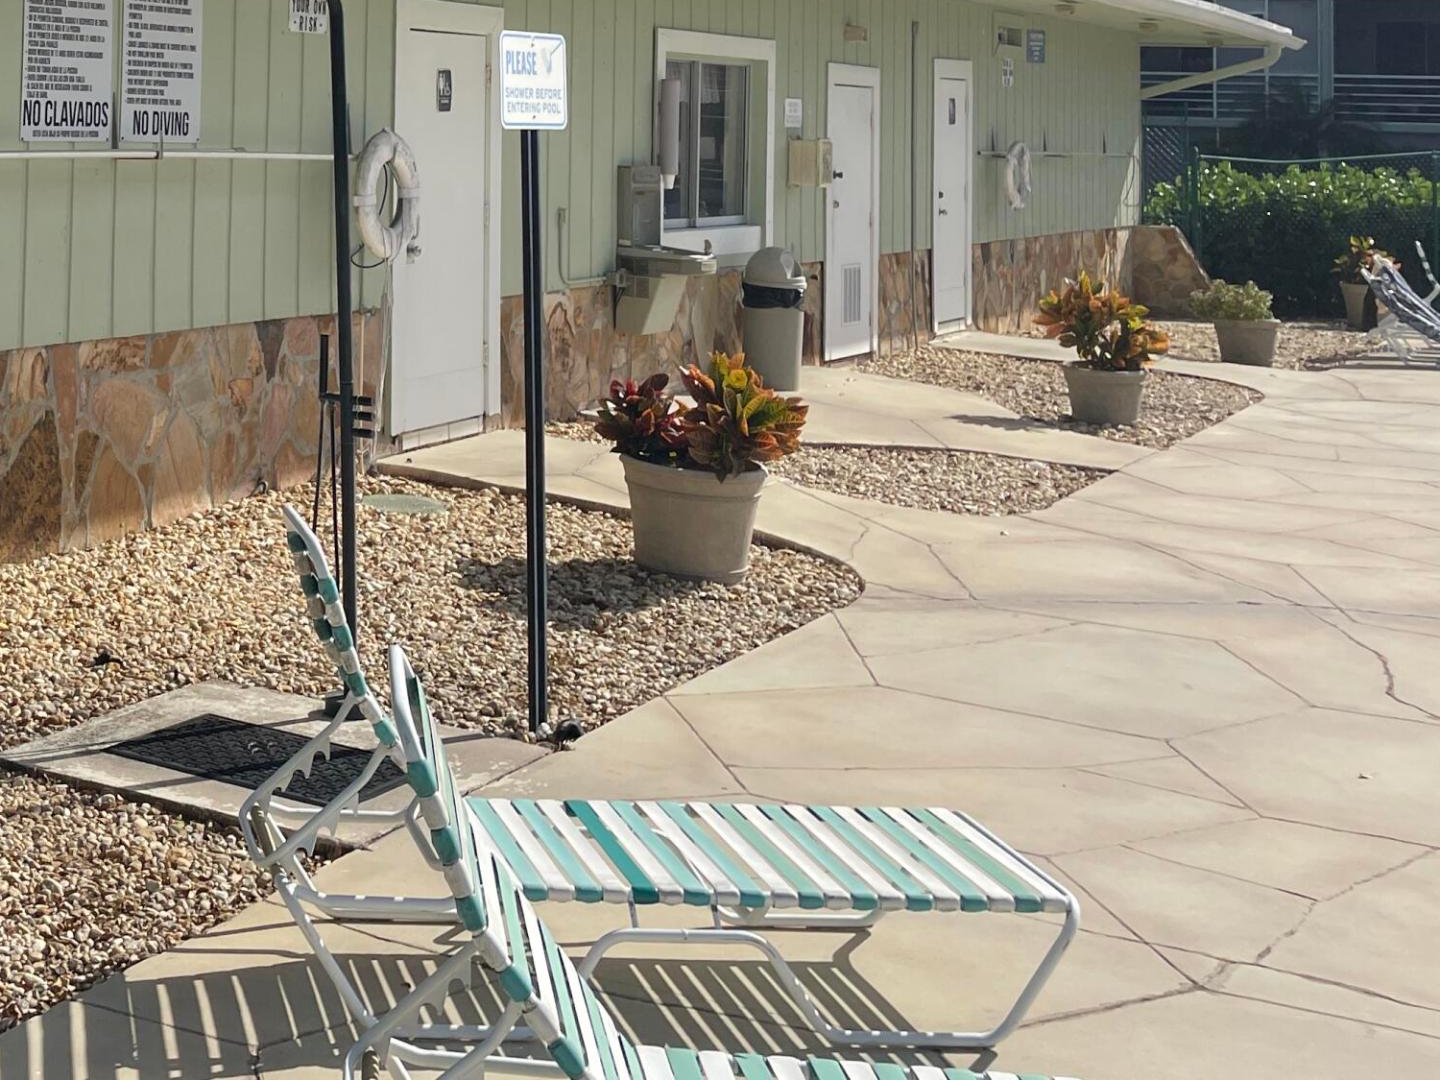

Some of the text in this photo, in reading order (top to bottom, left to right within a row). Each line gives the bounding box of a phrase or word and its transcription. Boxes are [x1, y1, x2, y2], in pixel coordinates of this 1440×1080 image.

[299, 15, 317, 32] RISK
[505, 49, 537, 76] PLEASE
[505, 87, 562, 100] SHOWER BEFORE
[23, 99, 109, 128] NO CLAVADOS
[507, 101, 561, 114] ENTERING POOL
[133, 110, 190, 136] NO DIVING
